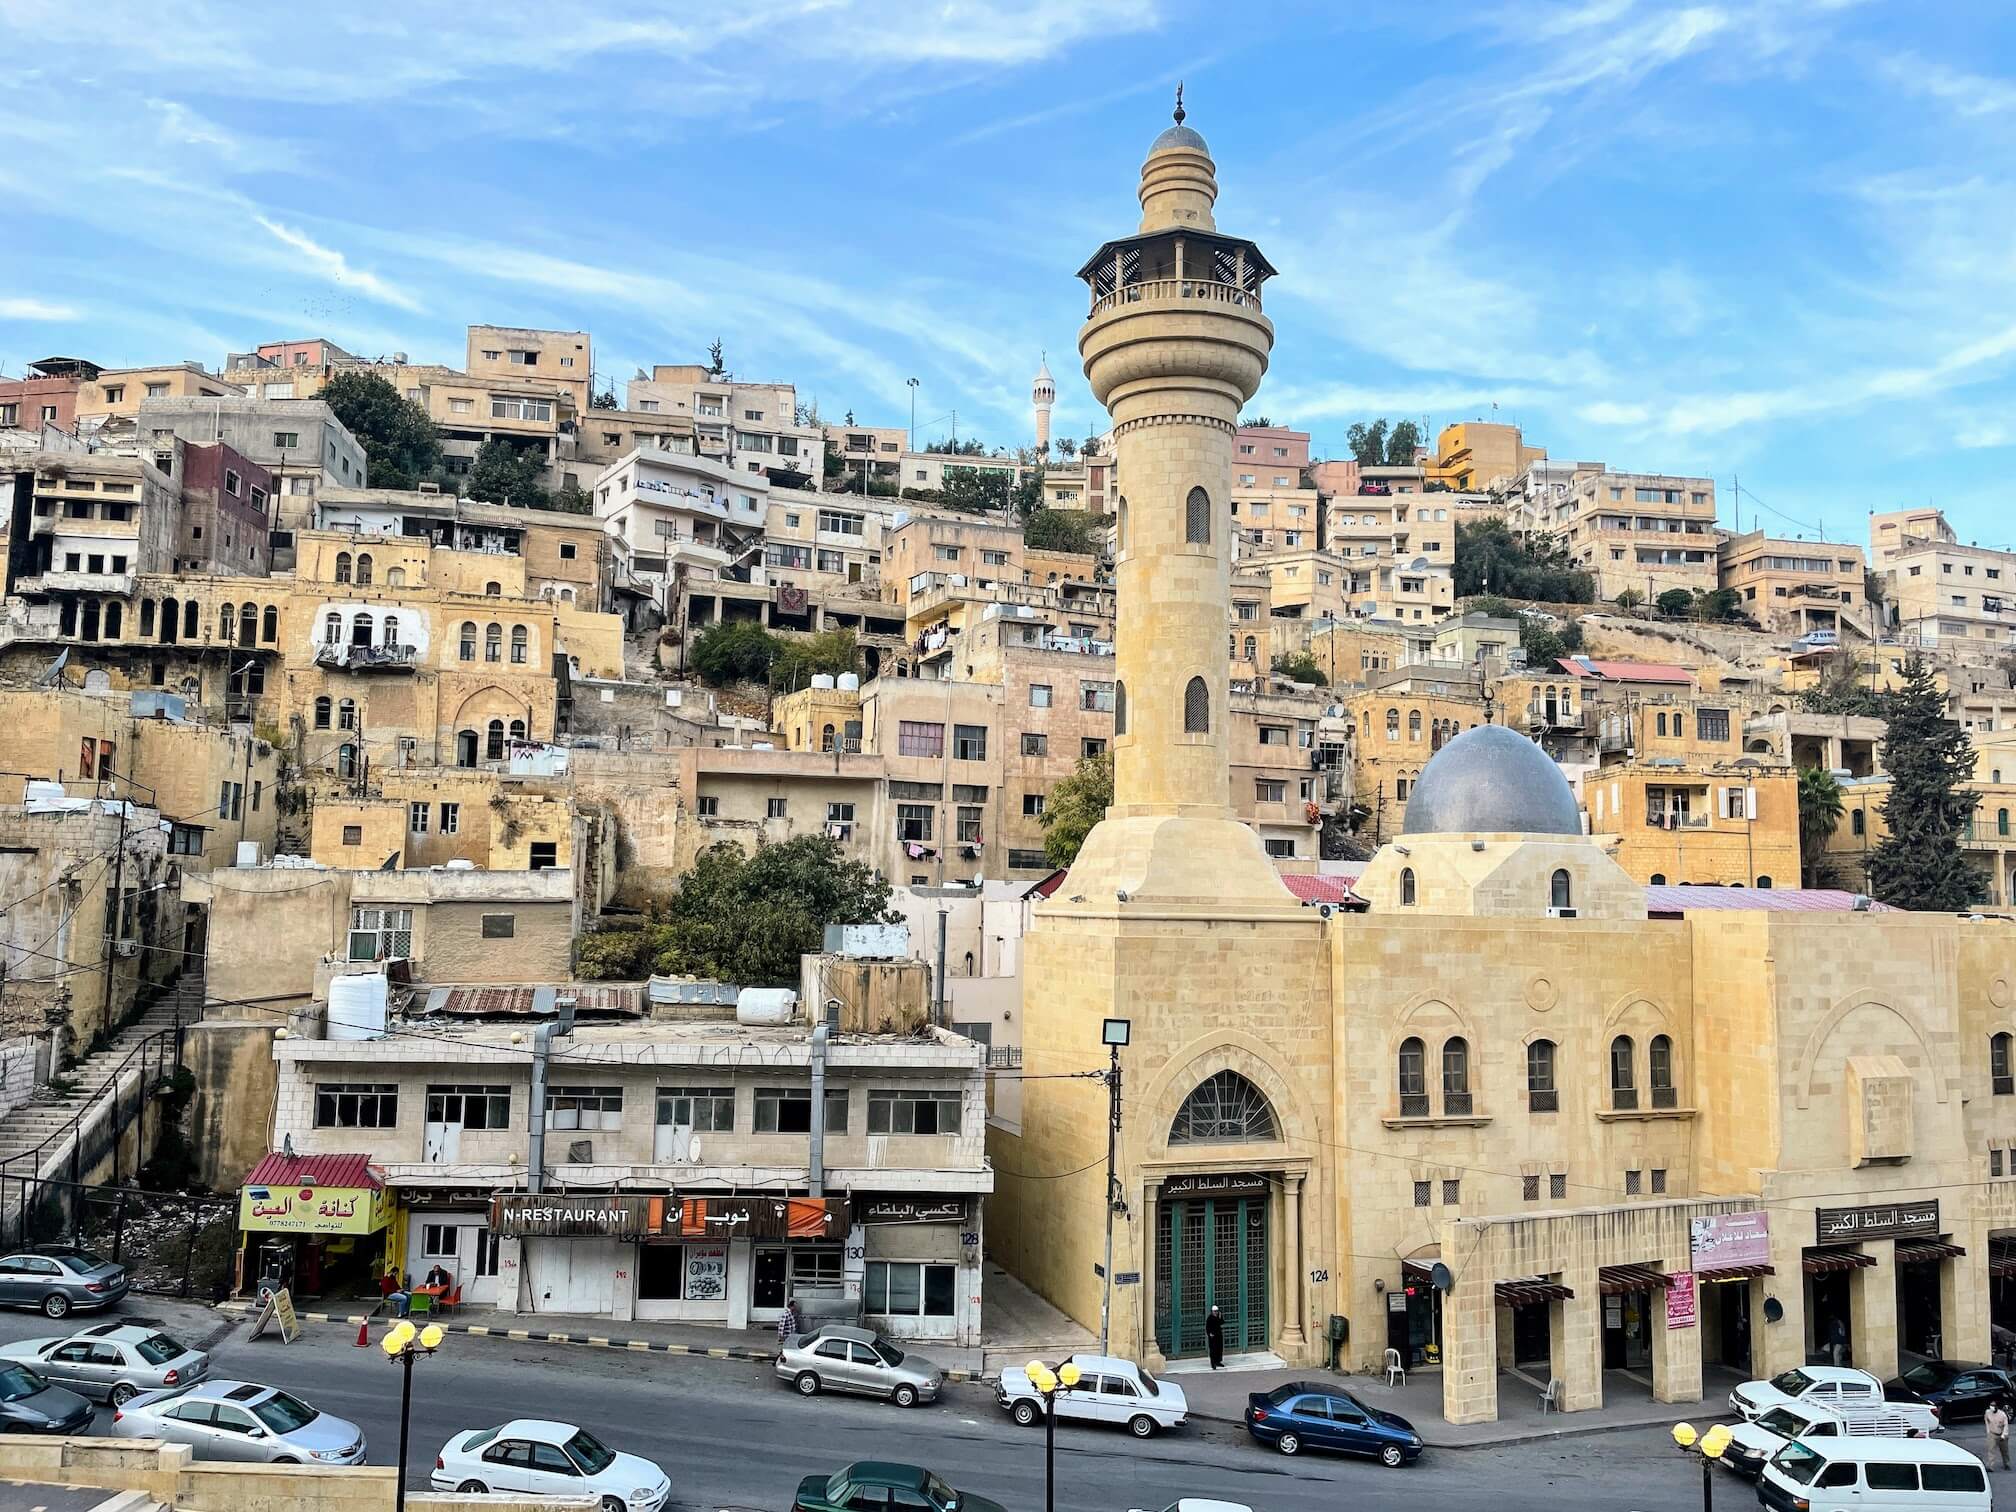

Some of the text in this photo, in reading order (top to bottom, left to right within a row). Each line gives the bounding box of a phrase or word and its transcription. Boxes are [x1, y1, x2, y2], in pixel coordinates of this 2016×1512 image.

[1168, 1177, 1263, 1193] مسجد السلط الكبير
[868, 1203, 959, 1220] تكسي البلقاء
[1828, 1210, 1936, 1234] مسجد السلط الكبير
[961, 1232, 979, 1246] 128
[845, 1247, 865, 1260] 130
[1310, 1269, 1329, 1284] 124
